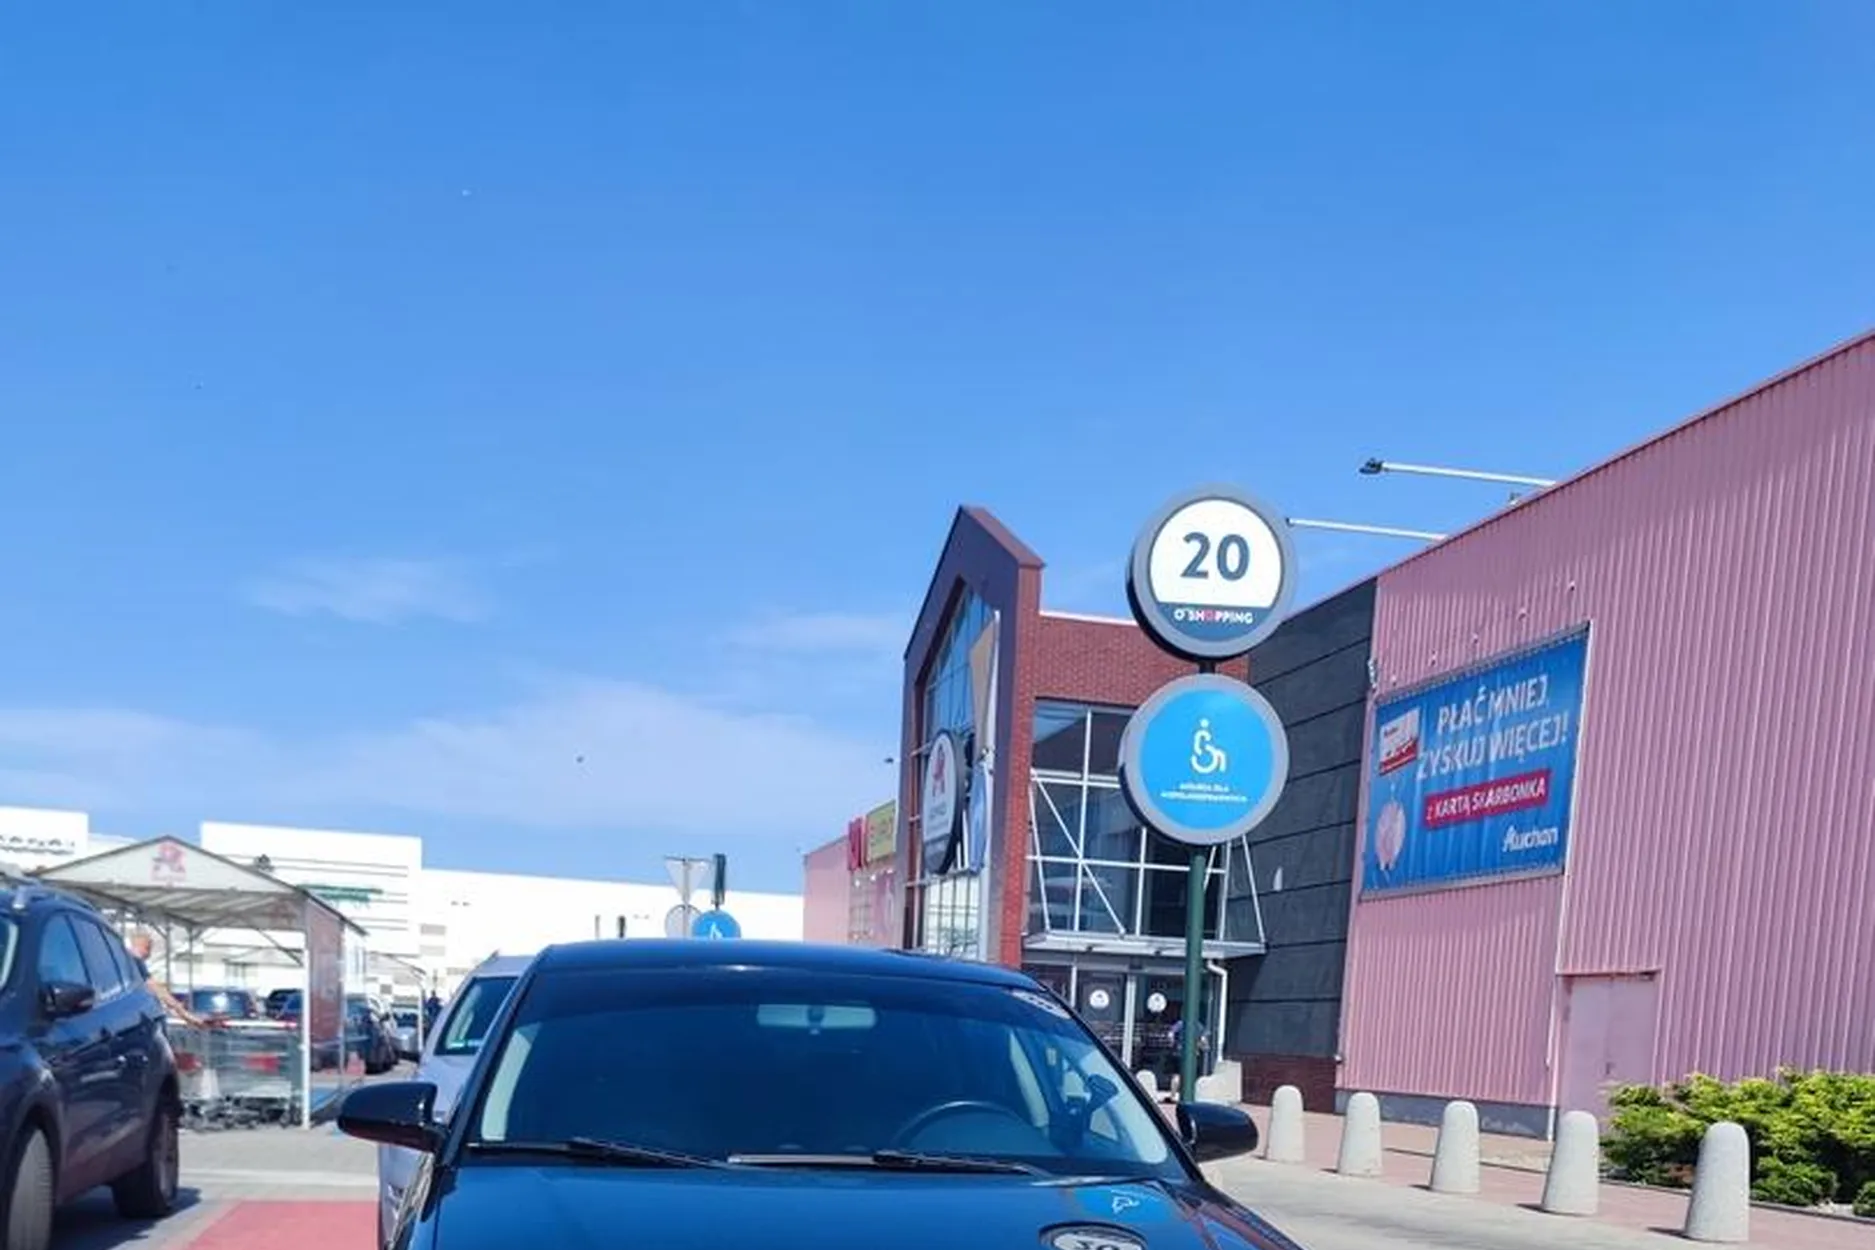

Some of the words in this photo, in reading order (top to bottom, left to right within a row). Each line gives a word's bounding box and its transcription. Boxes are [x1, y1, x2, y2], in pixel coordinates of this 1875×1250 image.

[1180, 531, 1251, 582] 20
[1437, 683, 1488, 736] PŁAĆ
[1488, 673, 1549, 720] MNIEJ
[1488, 709, 1570, 764] WIĘCEJ!
[1501, 824, 1559, 853] Auchan
